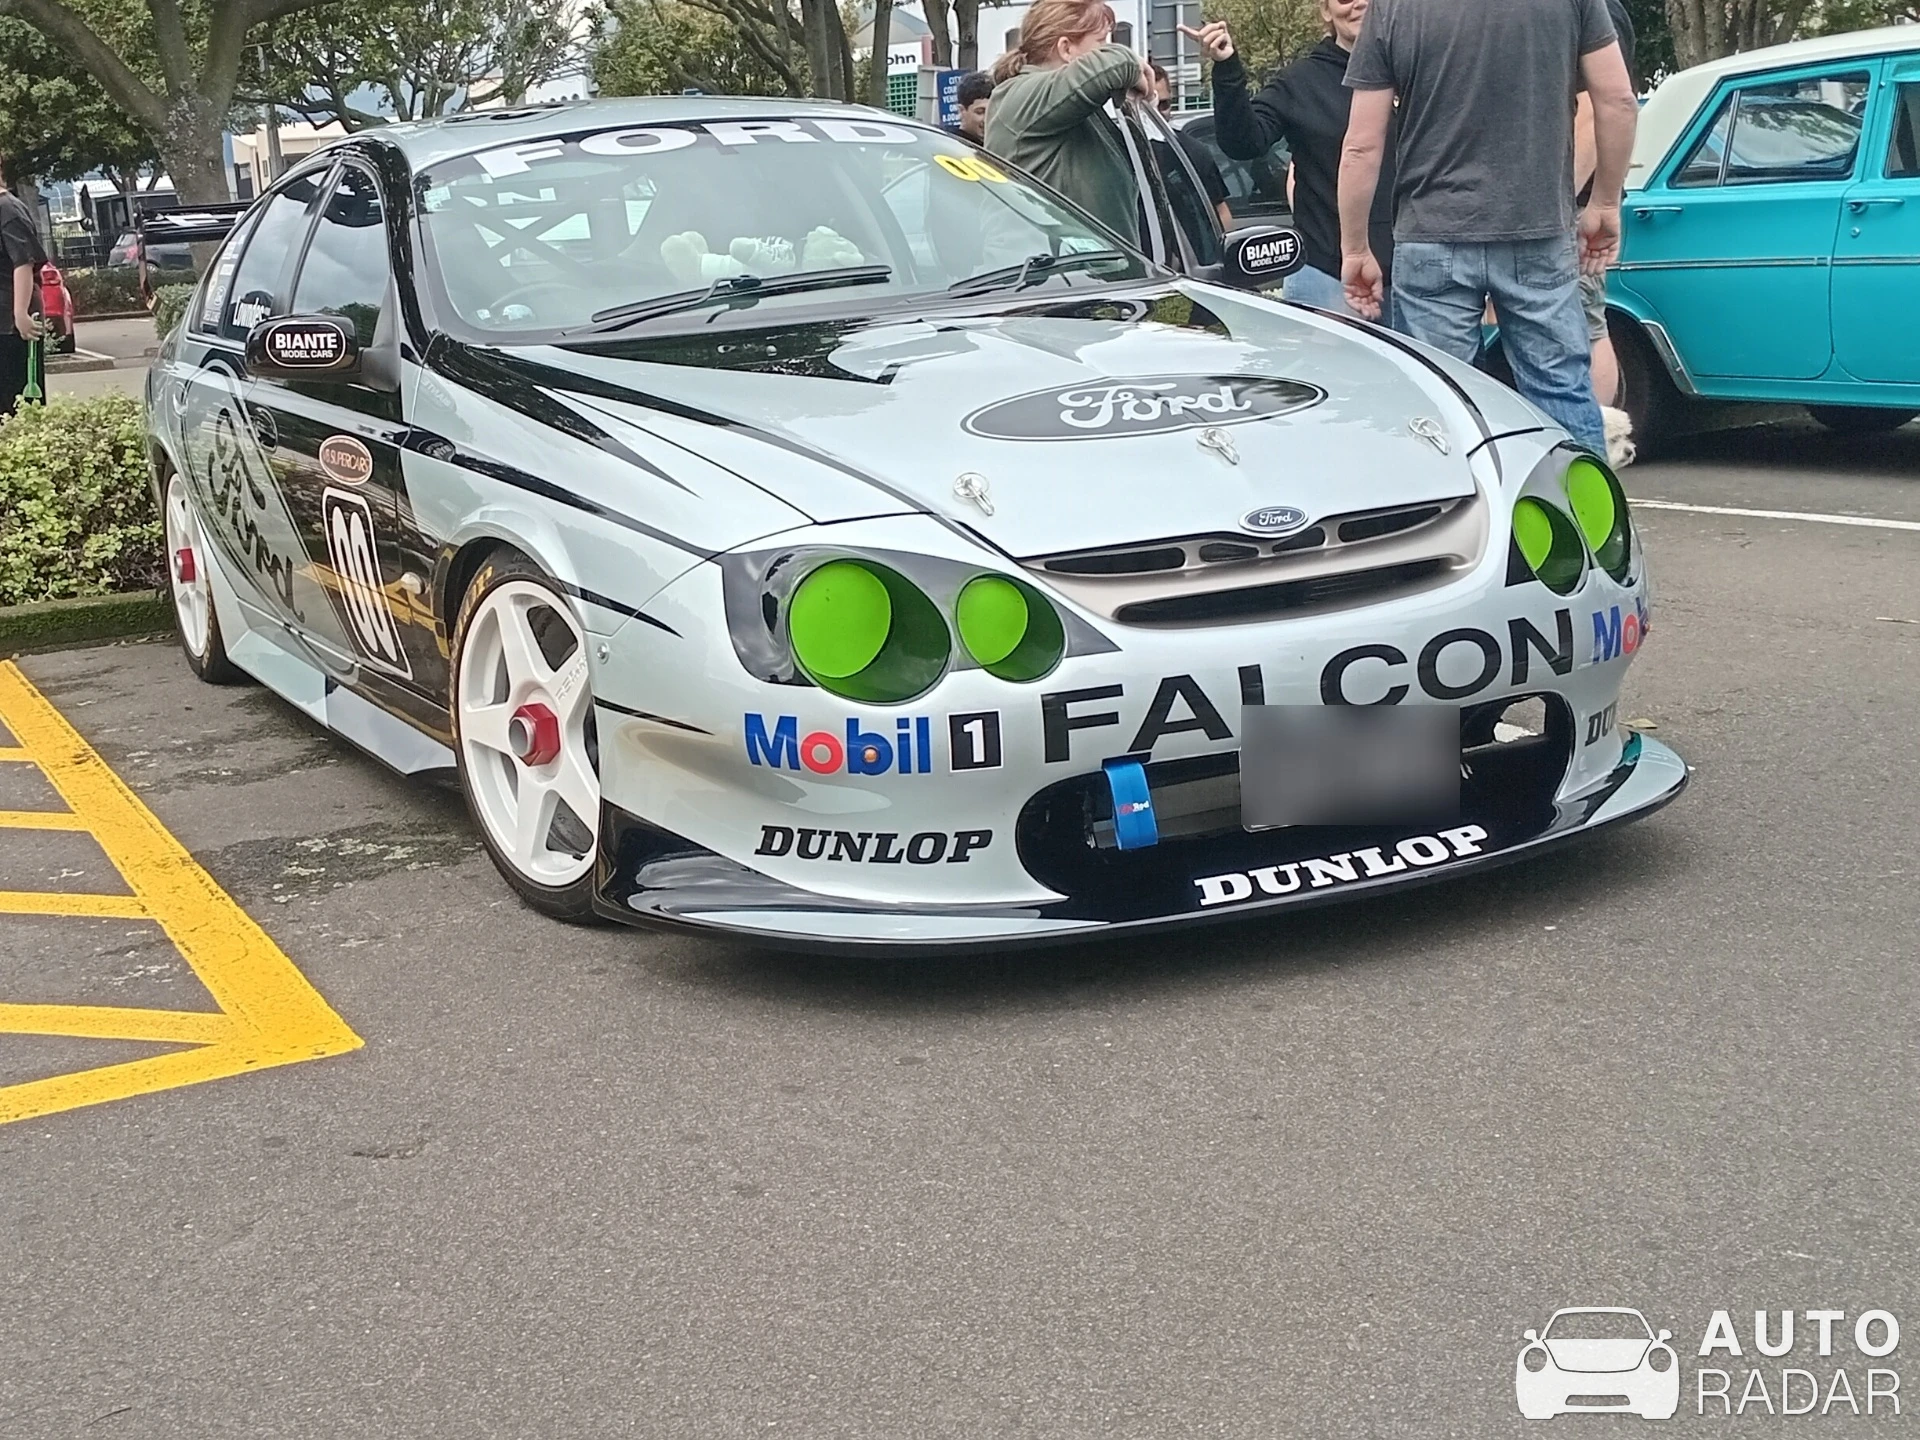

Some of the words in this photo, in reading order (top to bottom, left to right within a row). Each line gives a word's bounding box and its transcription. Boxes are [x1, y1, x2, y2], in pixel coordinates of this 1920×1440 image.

[886, 53, 916, 66] ohn
[473, 120, 918, 180] FORD
[933, 154, 1009, 184] 00
[1246, 238, 1294, 261] BIANTE
[1250, 257, 1273, 268] MODEL
[1273, 253, 1291, 264] CARS
[275, 333, 338, 350] BIANTE
[281, 349, 310, 358] MODEL
[310, 349, 334, 358] CARS
[1057, 382, 1252, 429] Ford
[330, 449, 370, 473] SUPERCARS
[209, 408, 306, 624] Ford
[1258, 510, 1293, 526] Ford
[331, 505, 397, 663] 00
[1584, 700, 1617, 747] DU
[744, 712, 932, 776] Mobil
[754, 825, 994, 865] DUNLOP
[1193, 824, 1489, 906] DUNLOP
